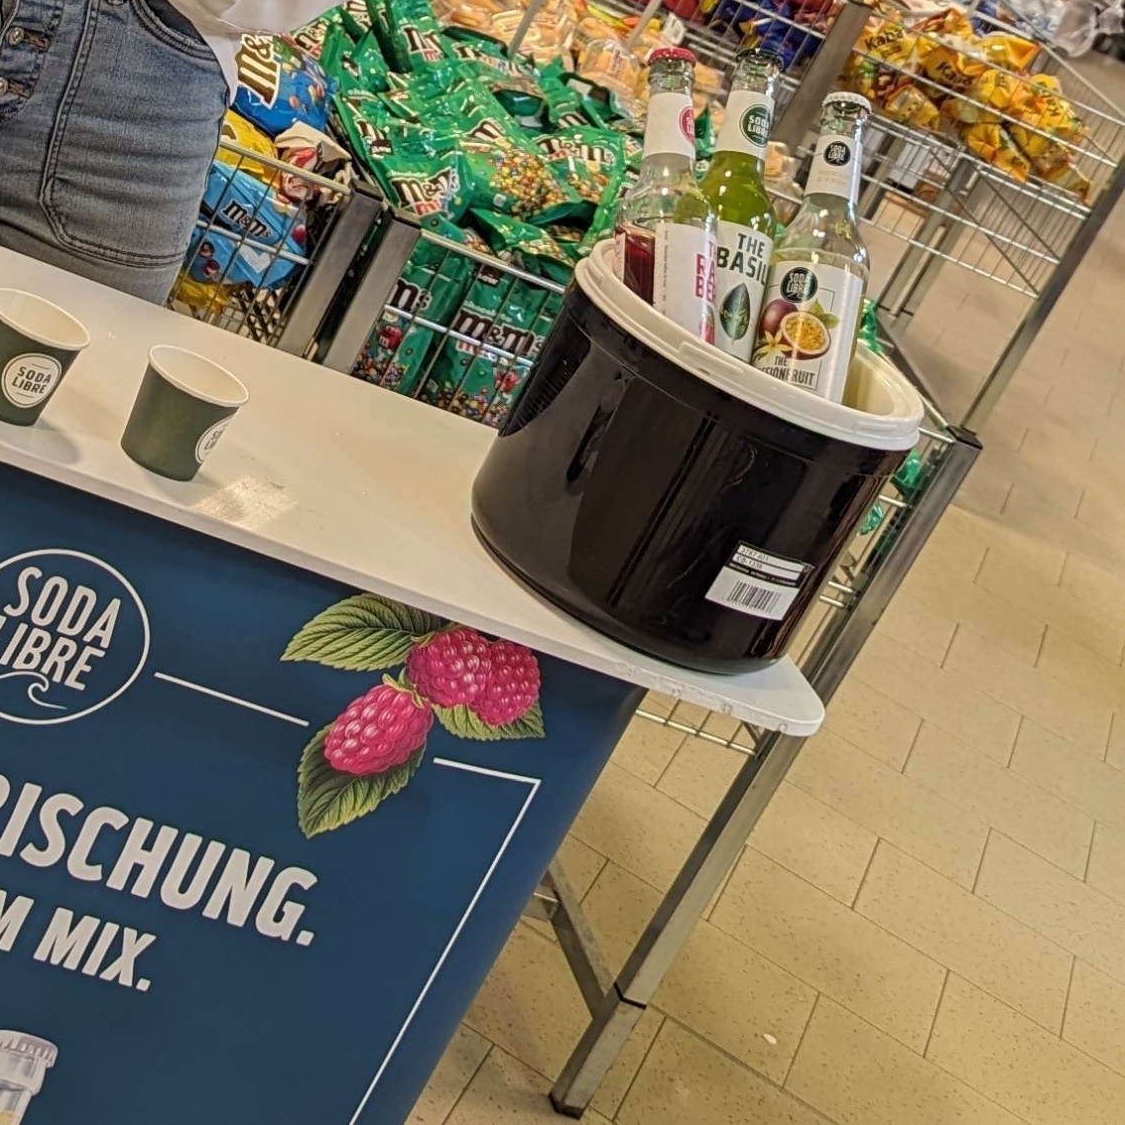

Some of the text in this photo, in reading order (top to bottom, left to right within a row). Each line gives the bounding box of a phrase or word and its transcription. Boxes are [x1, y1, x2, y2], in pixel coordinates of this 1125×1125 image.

[737, 232, 766, 259] THE
[716, 246, 770, 287] BASIL
[774, 355, 788, 367] THE
[11, 378, 48, 395] LIBRE
[17, 365, 52, 385] SODA
[4, 565, 122, 652] SODA
[33, 905, 157, 993] MIX.
